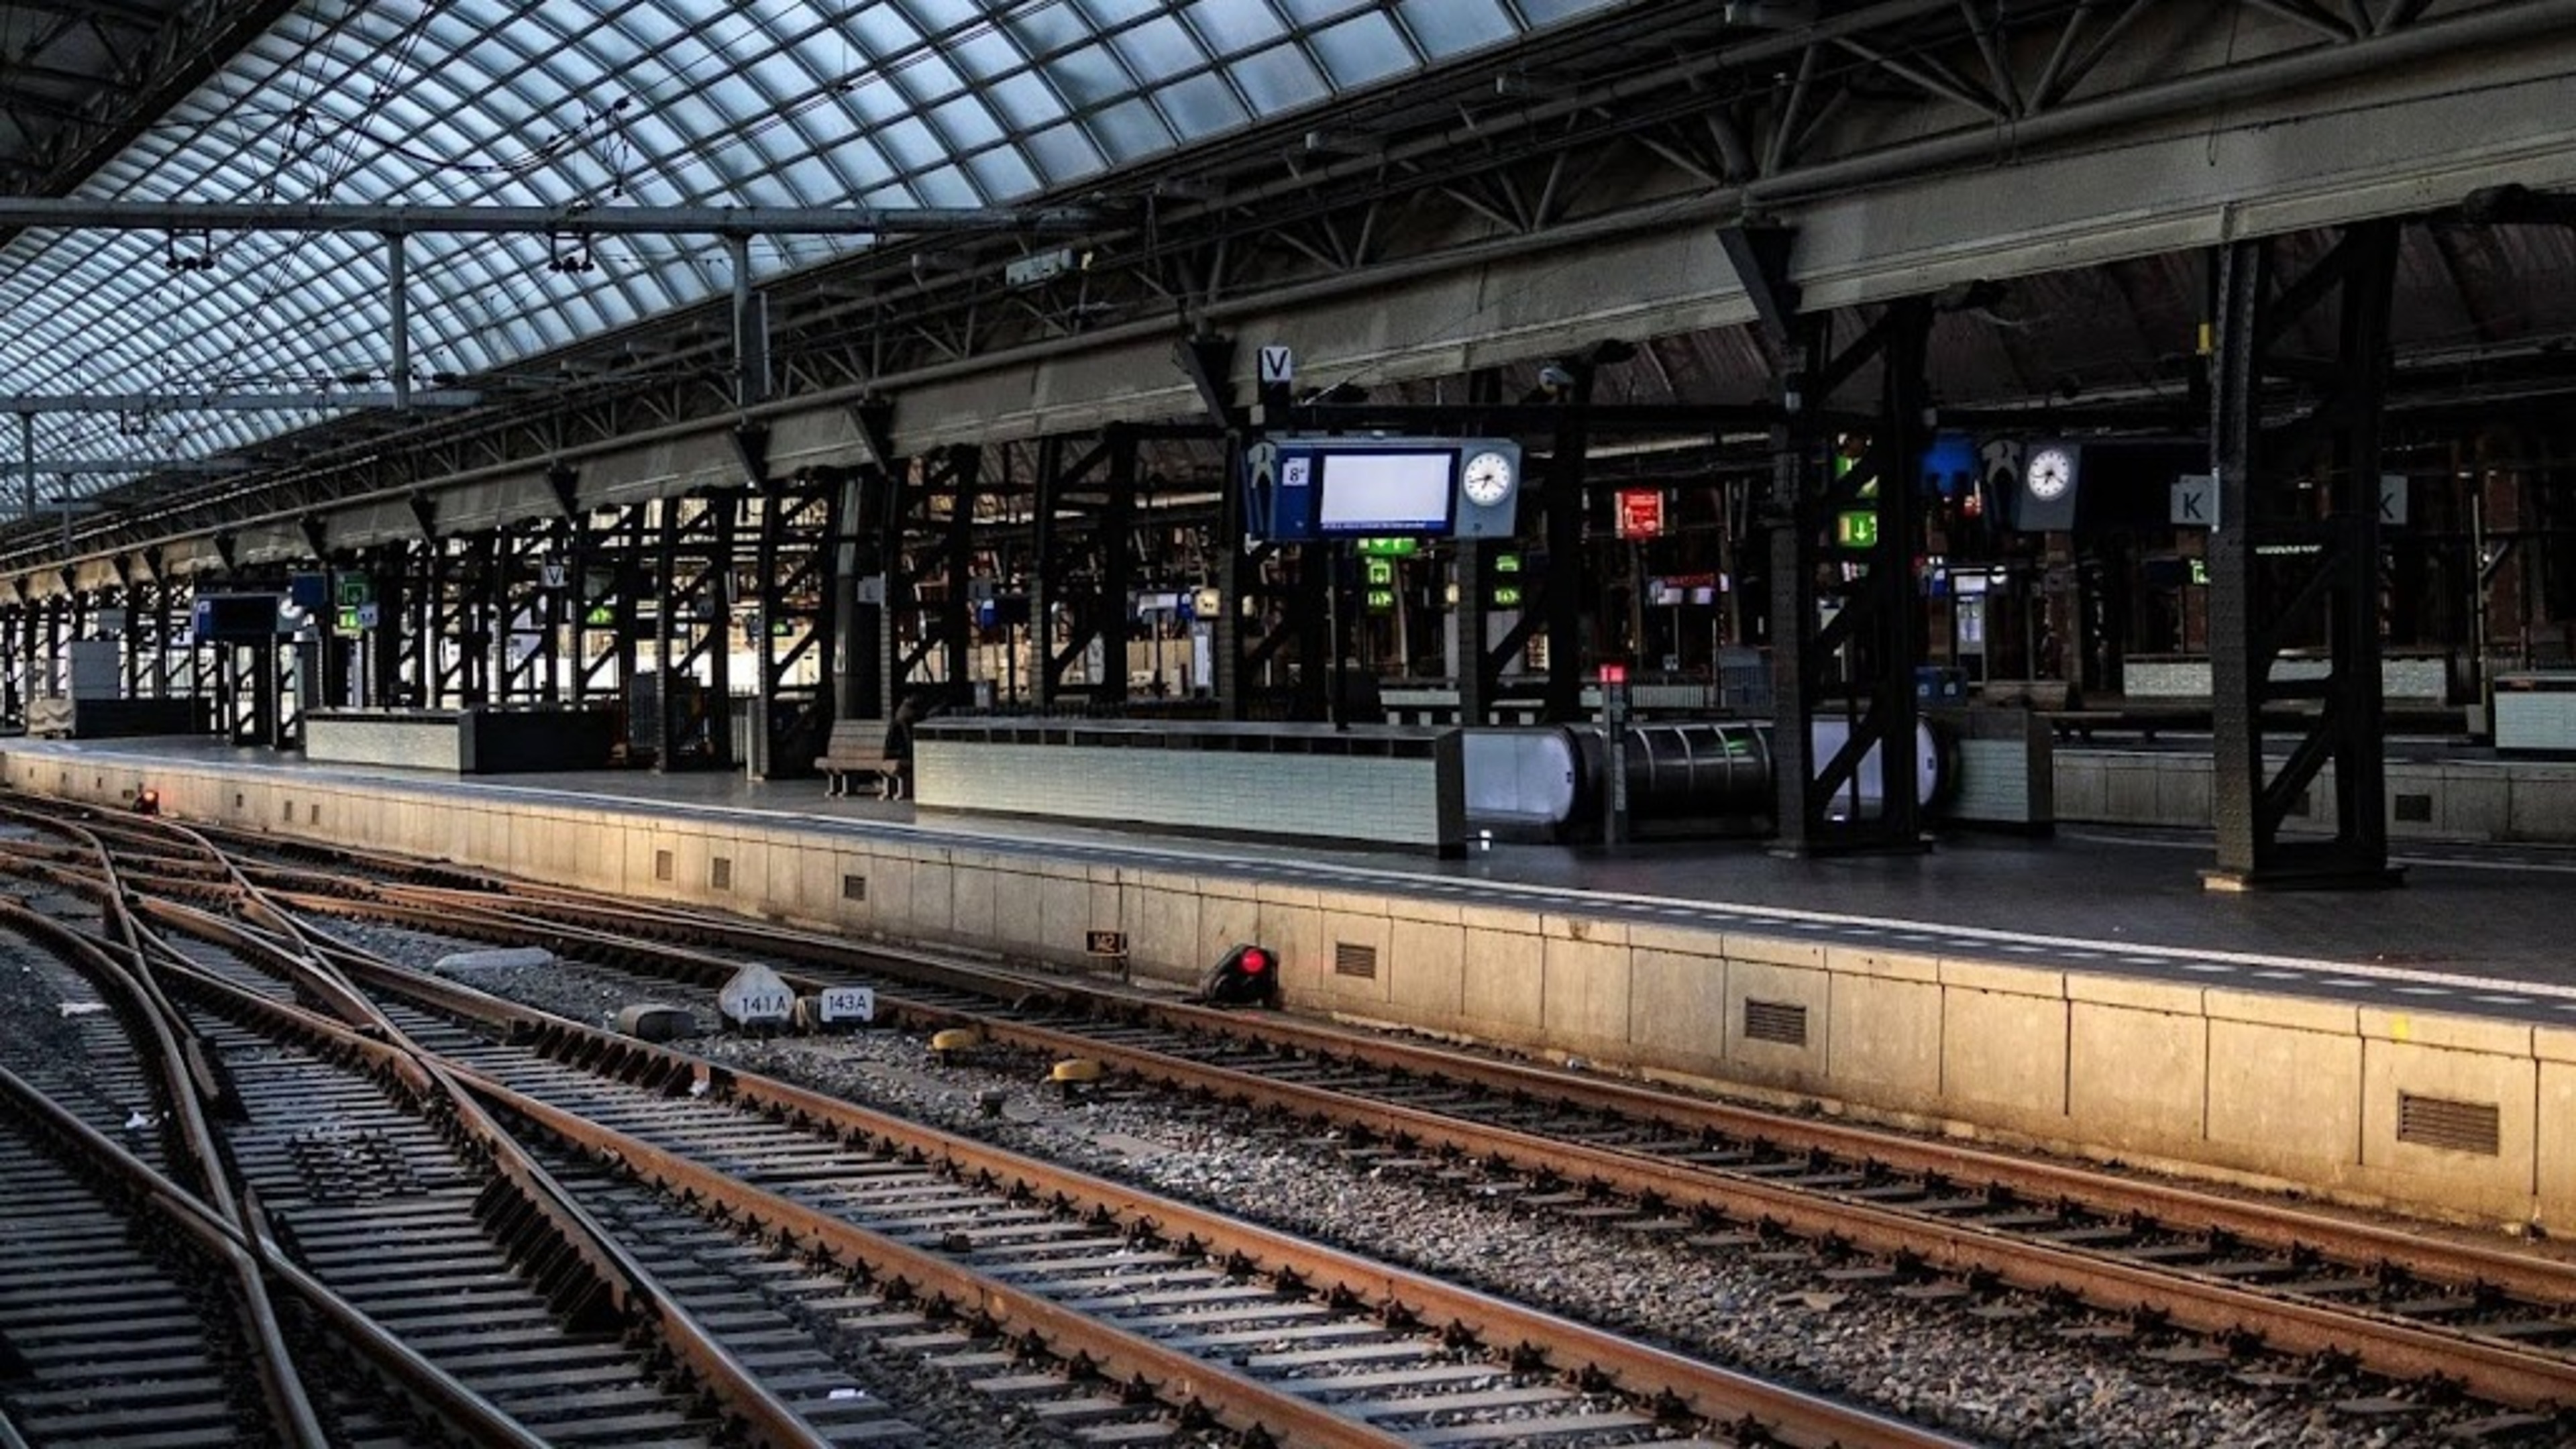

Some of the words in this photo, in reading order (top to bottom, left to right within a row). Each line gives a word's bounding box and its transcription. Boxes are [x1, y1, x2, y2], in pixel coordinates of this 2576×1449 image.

[1265, 350, 1288, 377] V
[2183, 492, 2202, 519] K
[548, 568, 561, 584] V
[742, 996, 787, 1014] 141A
[828, 995, 867, 1012] 143A
